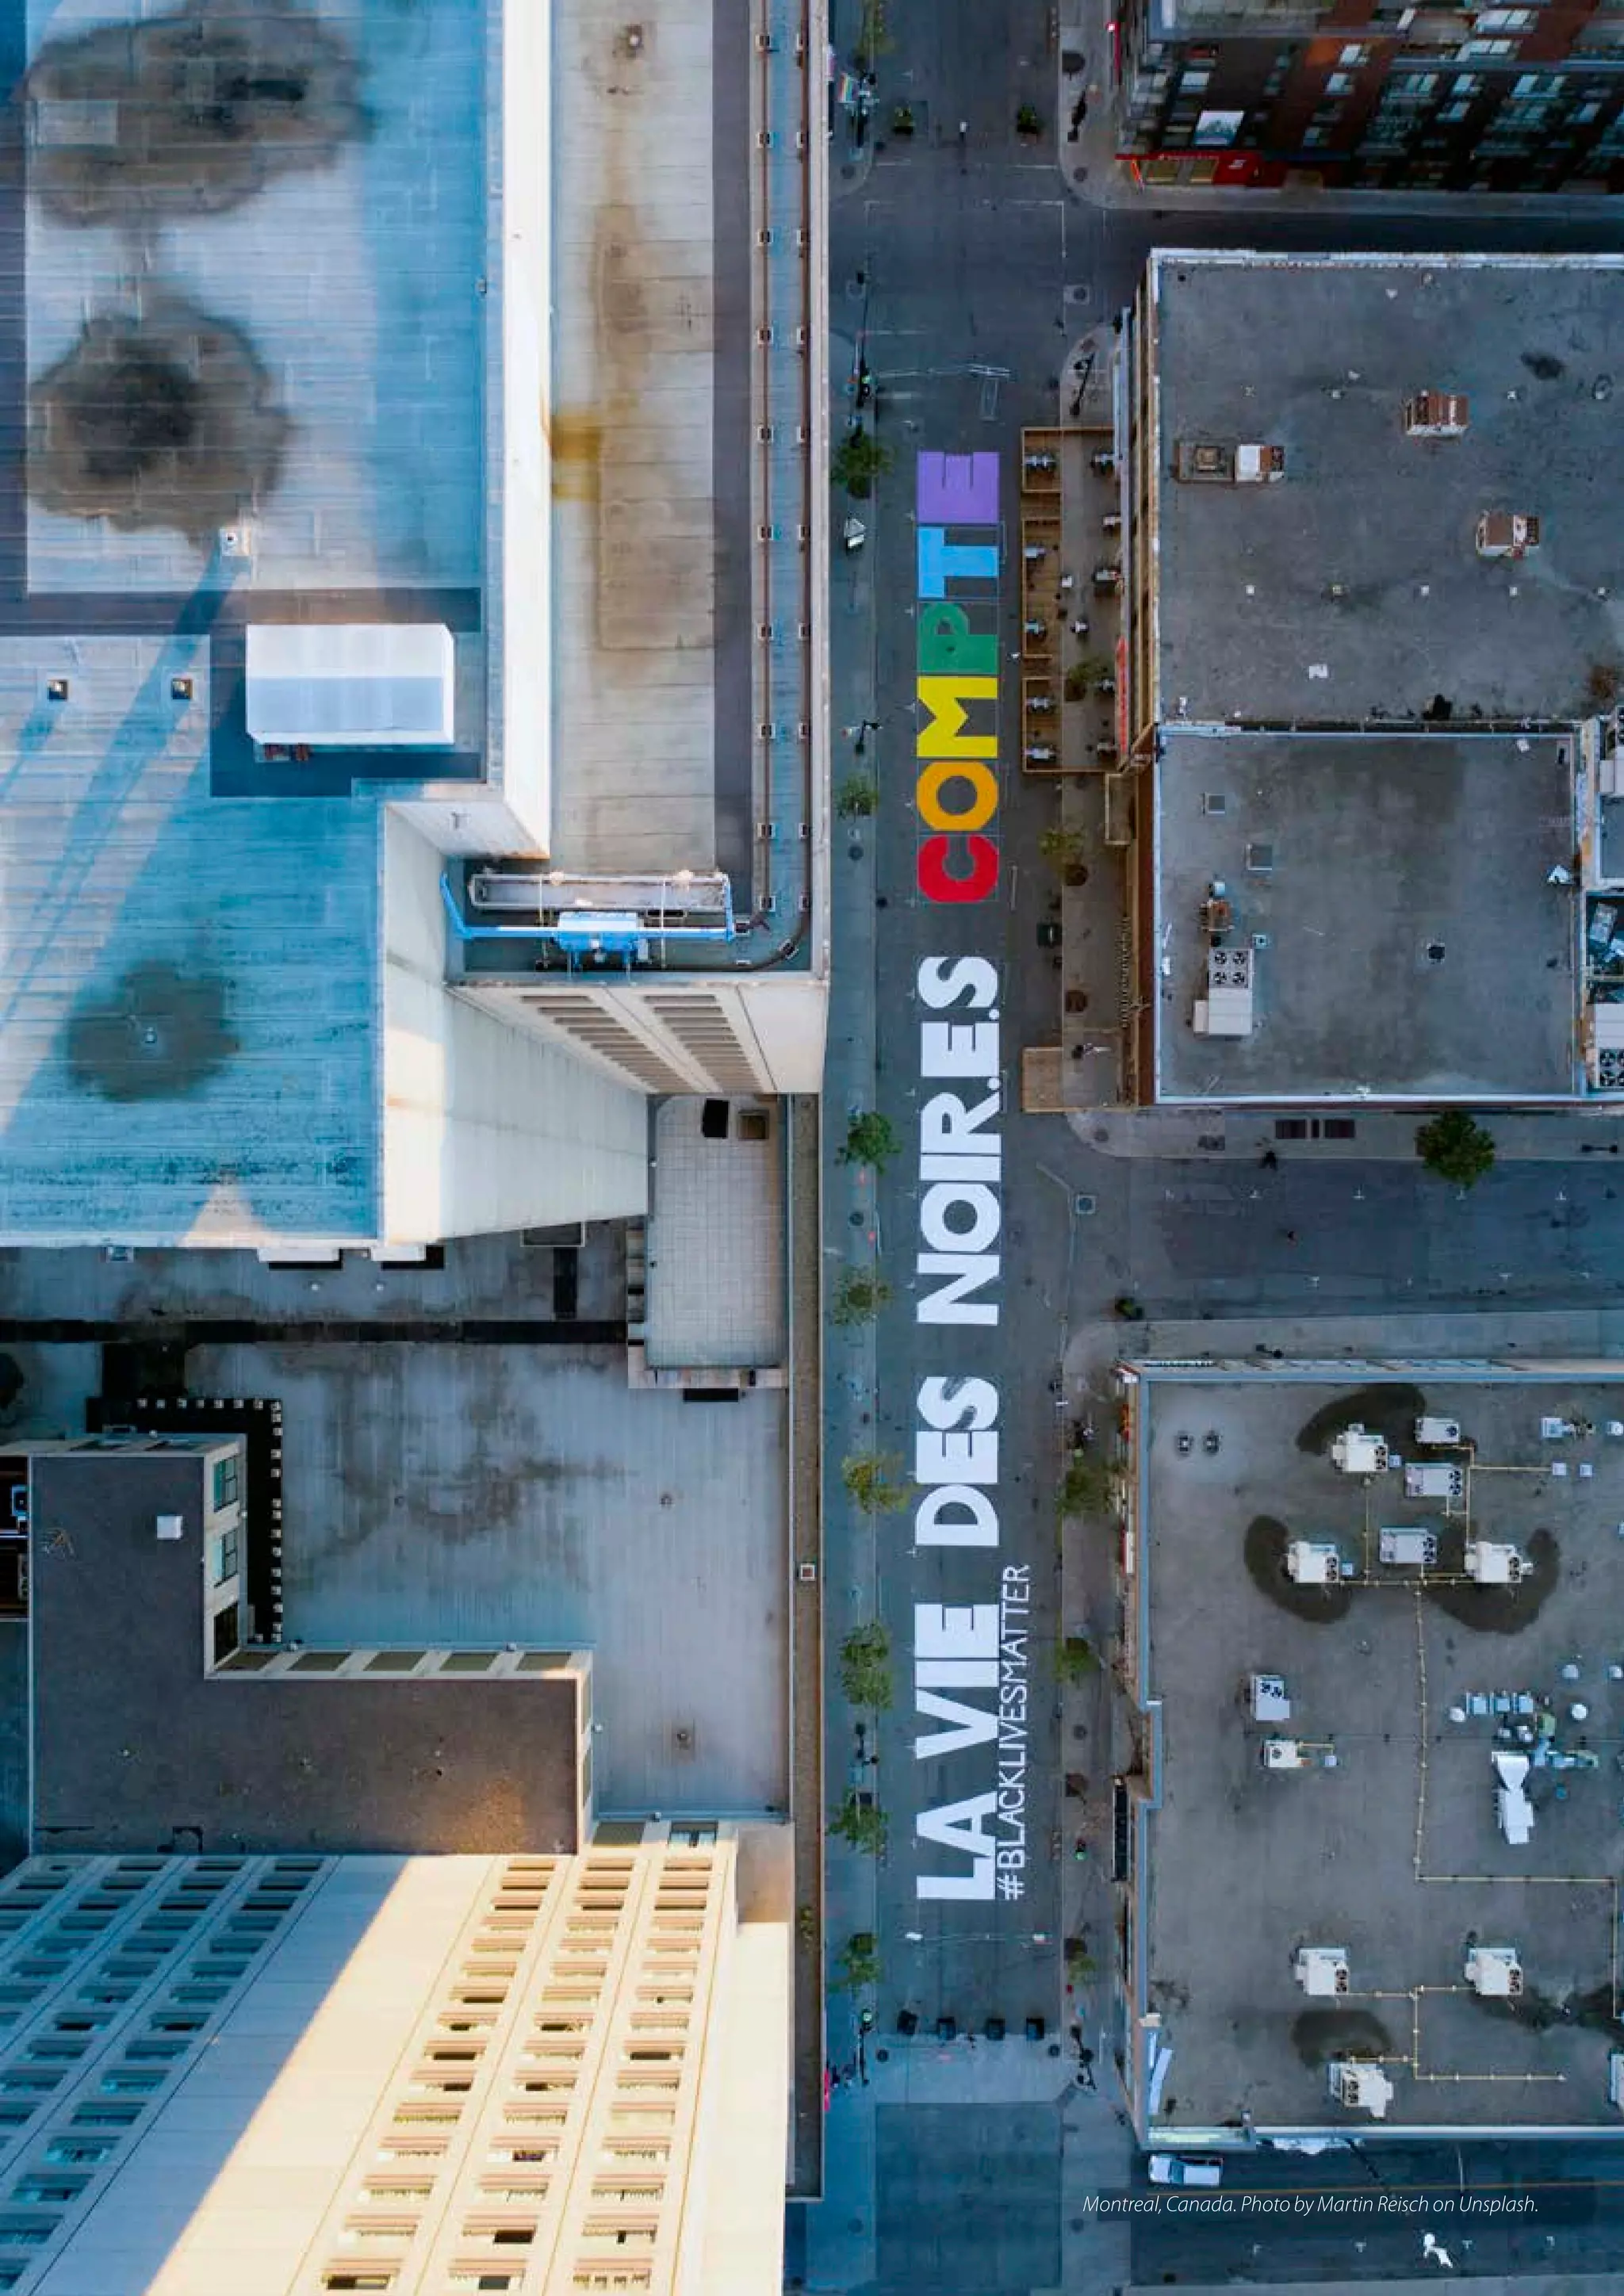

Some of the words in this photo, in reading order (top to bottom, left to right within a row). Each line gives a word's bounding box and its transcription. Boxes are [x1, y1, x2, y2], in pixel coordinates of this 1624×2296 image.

[916, 452, 1000, 903] COMPTE
[916, 956, 1002, 1325] NOIR.E.S
[914, 1376, 999, 1547] DES
[914, 1604, 1000, 1760] VIE
[997, 1564, 1032, 1900] #BLACKLIVESMATTER
[916, 1790, 998, 1900] LA
